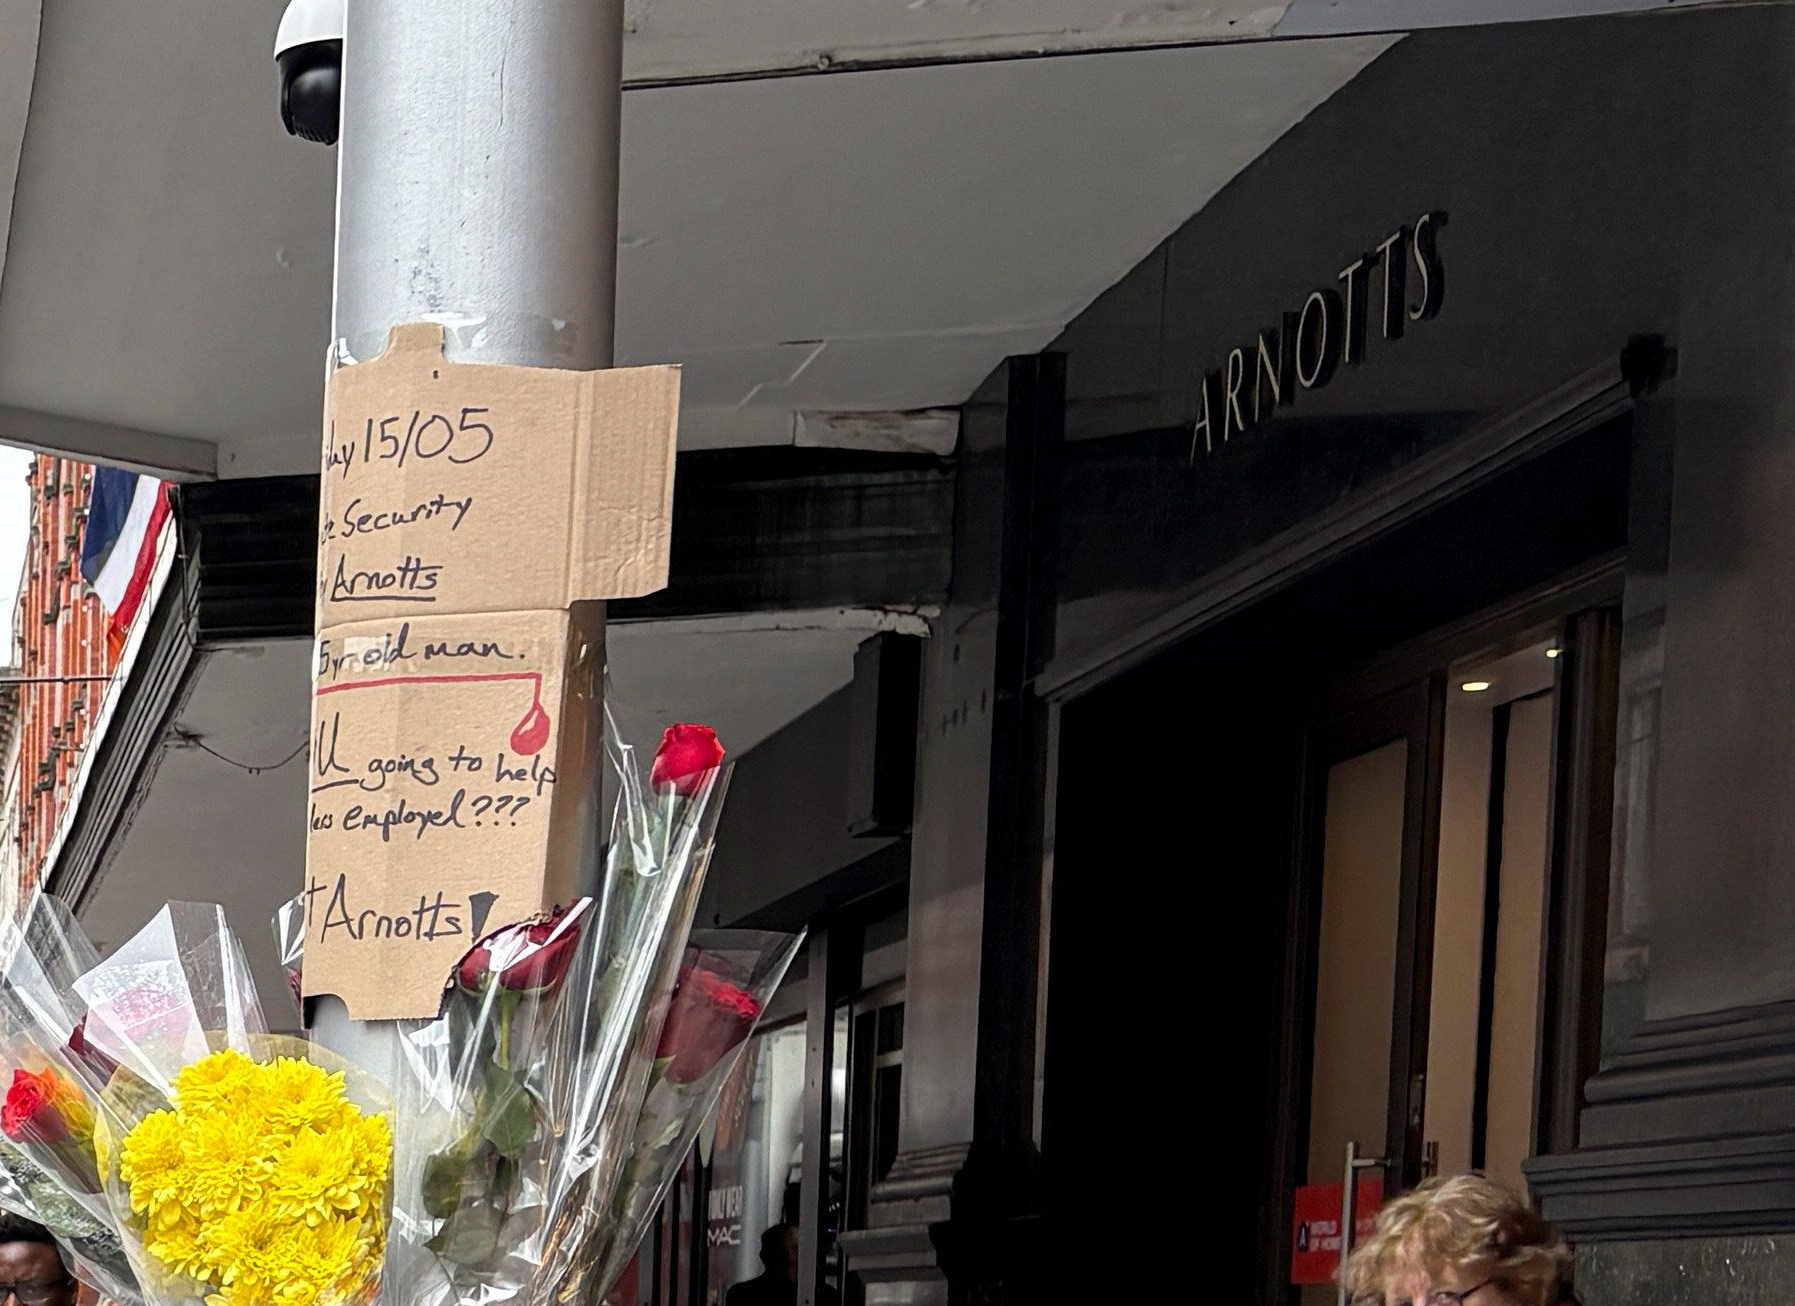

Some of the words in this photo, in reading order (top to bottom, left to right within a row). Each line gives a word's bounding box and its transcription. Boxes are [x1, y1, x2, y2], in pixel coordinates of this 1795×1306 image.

[1190, 210, 1449, 465] ARNOTTS
[364, 408, 494, 468] 15/05
[341, 494, 473, 538] Security
[330, 553, 444, 600] Arnotts
[362, 622, 417, 665] old
[360, 755, 440, 792] going
[448, 745, 483, 771] to
[495, 753, 557, 796] help
